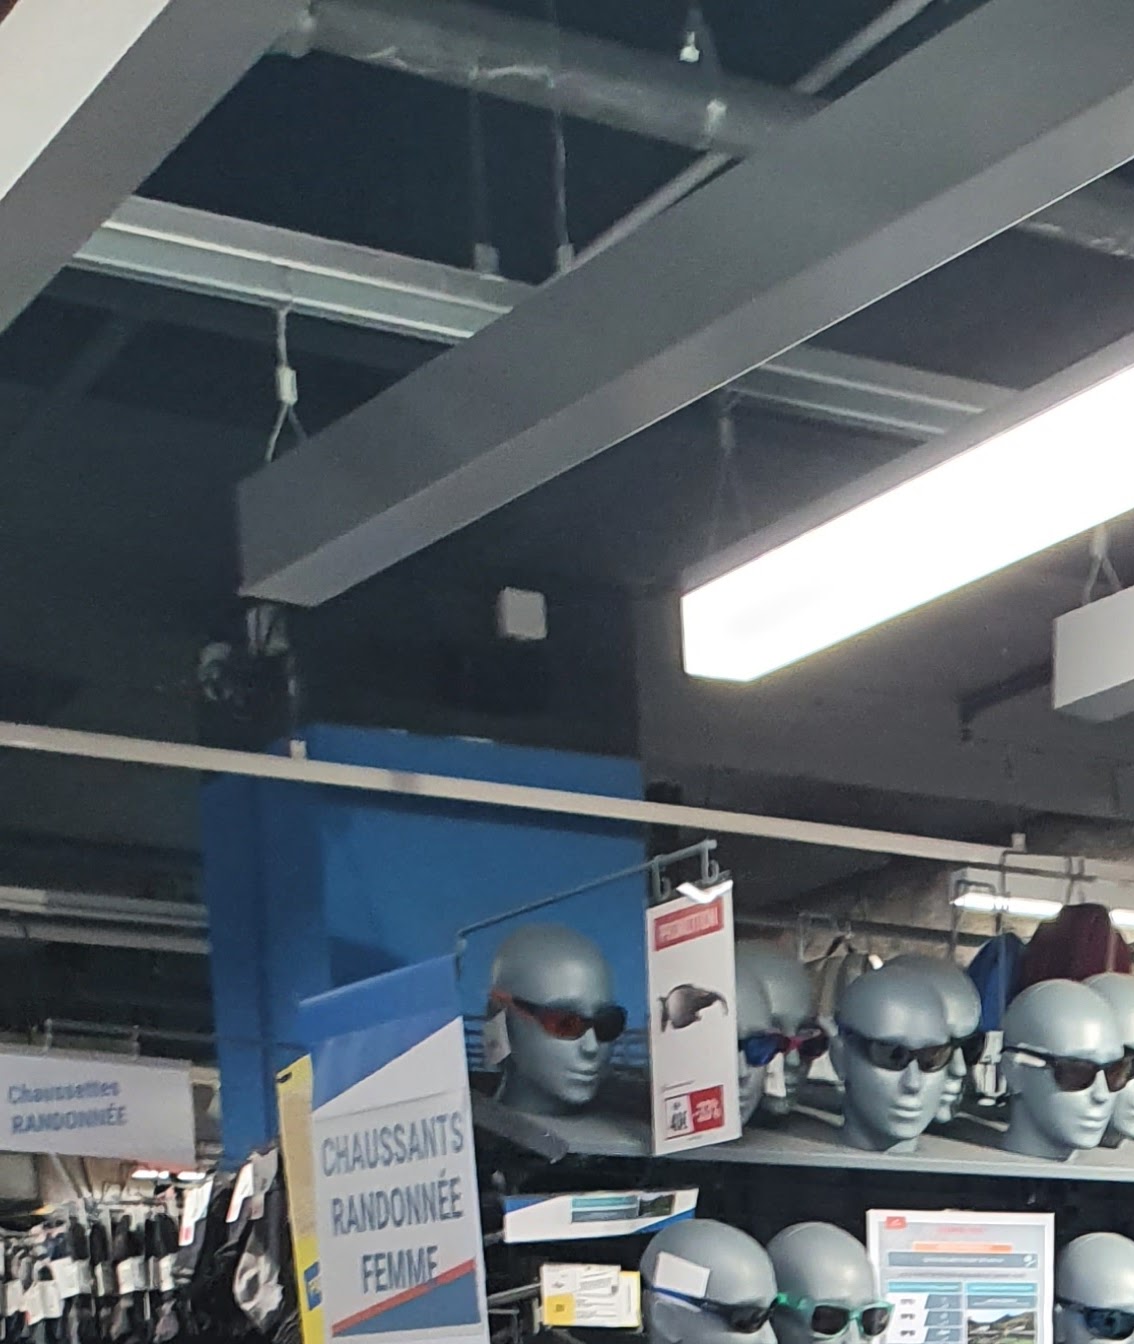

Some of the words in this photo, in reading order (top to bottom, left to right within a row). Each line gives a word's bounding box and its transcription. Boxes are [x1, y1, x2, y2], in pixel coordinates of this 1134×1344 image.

[321, 1111, 464, 1177] CHAUSSANTS
[331, 1168, 464, 1236] RANDONNÉE
[361, 1245, 438, 1294] FEMME
